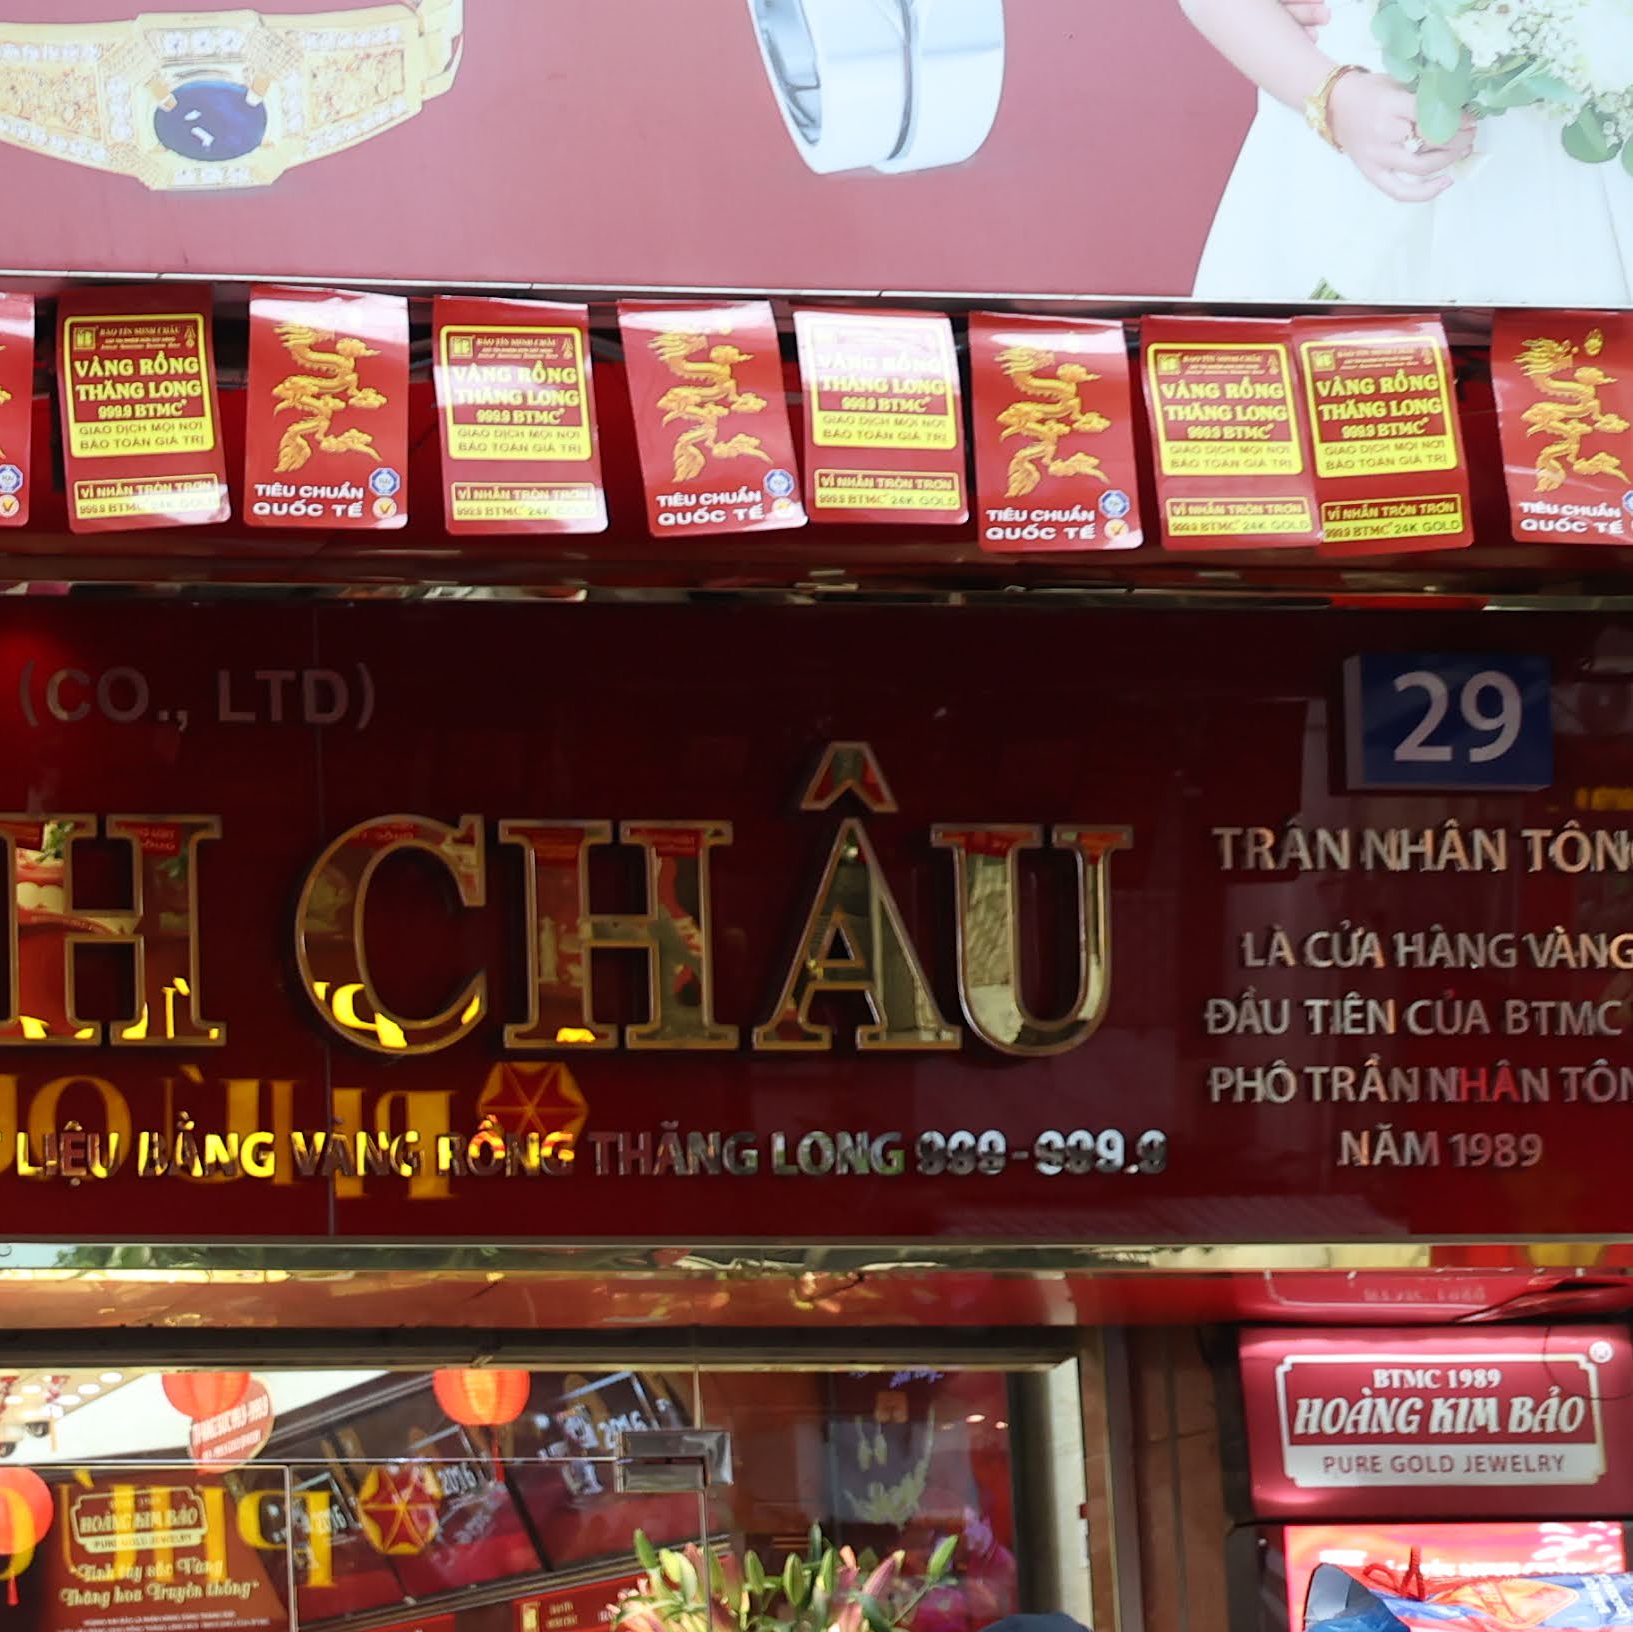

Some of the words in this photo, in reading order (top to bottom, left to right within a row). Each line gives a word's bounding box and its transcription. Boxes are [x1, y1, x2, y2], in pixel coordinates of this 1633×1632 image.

[1316, 377, 1375, 397] VÀNG
[1380, 370, 1438, 393] RỒNG
[1319, 400, 1387, 421] THĂNG
[1391, 398, 1442, 417] LONG
[1393, 671, 1523, 763] 29
[1363, 817, 1508, 872] NHÂN
[1521, 818, 1633, 873] TÔN
[295, 742, 1133, 1057] CHÂU
[1241, 923, 1297, 968] LÀ
[1392, 922, 1518, 969] HÀNG
[1526, 924, 1633, 969] VÀNG
[1505, 1001, 1623, 1035] BTMC
[1427, 1059, 1549, 1102] NHÂN
[1560, 1058, 1633, 1102] TÔN
[589, 1120, 758, 1177] THĂNG
[770, 1130, 903, 1177] LONG
[1337, 1122, 1440, 1167] NĂM
[1447, 1132, 1543, 1168] 1989
[1373, 1368, 1441, 1390] BTMC
[1447, 1368, 1502, 1389] 1989
[1294, 1386, 1423, 1435] HOÀNG
[1428, 1396, 1501, 1435] KIM
[1508, 1385, 1586, 1435] BẢO
[1323, 1454, 1382, 1474] PURE
[1390, 1454, 1454, 1474] GOLD
[1463, 1453, 1565, 1474] JEWELRY
